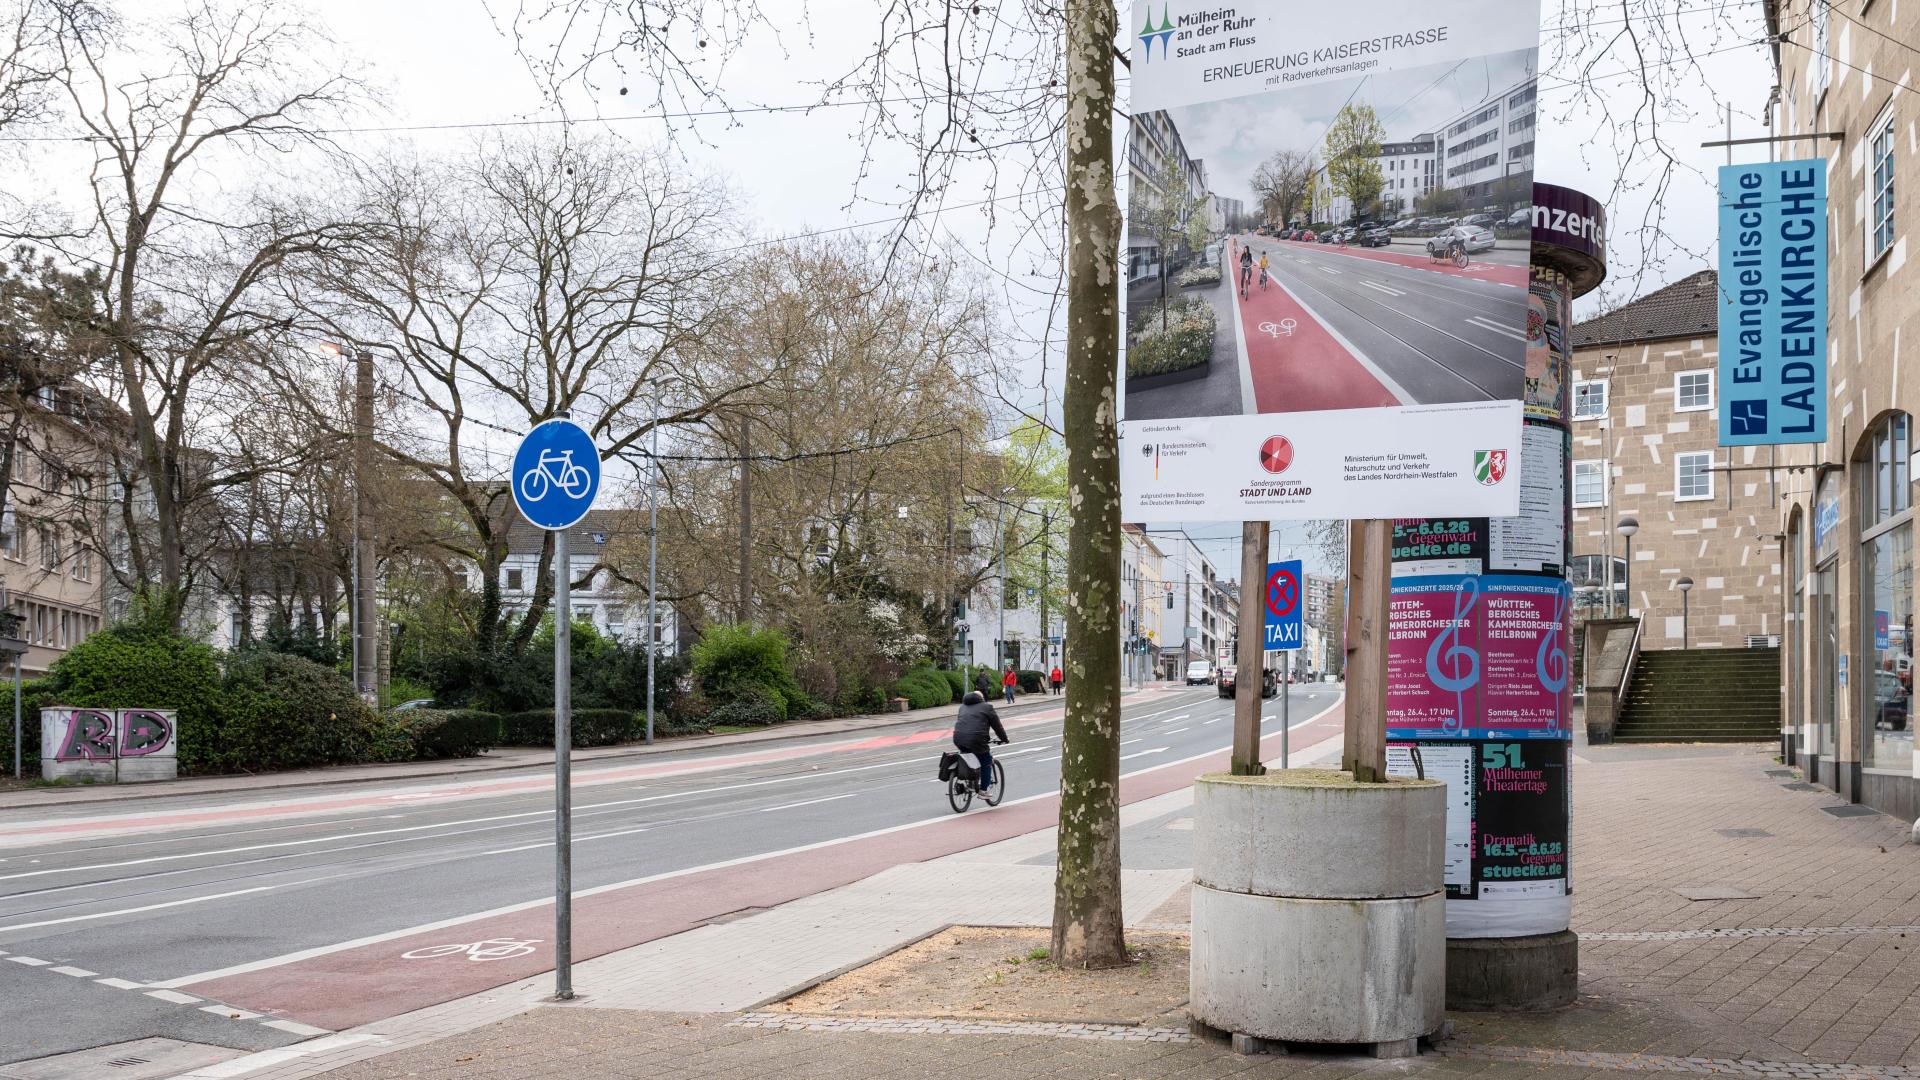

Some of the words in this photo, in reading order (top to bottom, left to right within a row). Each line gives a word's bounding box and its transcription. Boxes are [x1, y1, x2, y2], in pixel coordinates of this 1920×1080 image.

[1178, 8, 1235, 27] Mülheim
[1177, 30, 1192, 41] an
[1197, 23, 1219, 37] der
[1223, 17, 1256, 32] Ruhr
[1177, 45, 1206, 58] Stadt
[1209, 42, 1226, 52] am
[1229, 36, 1256, 48] Fluss
[1204, 51, 1308, 82] ERNEUERUNG
[1313, 26, 1448, 63] KAISERSTRASSE
[1265, 75, 1280, 86] mit
[1282, 59, 1379, 82] Radverkehrsanlagen
[1733, 172, 1768, 384] Evangelische
[1781, 168, 1815, 433] LADENKIRCHE
[1344, 455, 1385, 463] Ministerium
[1398, 453, 1428, 461] Umwelt,
[1344, 464, 1385, 472] Naturschutz
[1384, 471, 1458, 480] Nordrhein-Westfalen
[1240, 489, 1266, 497] STADT
[1268, 488, 1286, 496] UND
[1288, 487, 1312, 496] LAND
[1409, 530, 1477, 546] Gegenwart
[1438, 584, 1464, 592] 2025/26
[1487, 584, 1543, 593] SINFONIEKONZERTE
[1487, 598, 1535, 609] WÜRTTEM-
[1488, 609, 1540, 619] BERGISCHES
[1488, 619, 1563, 631] KAMMERORCHESTER
[1265, 622, 1299, 643] TAXI
[1488, 630, 1537, 639] HEILBRONN
[1430, 707, 1439, 716] 17
[1440, 707, 1455, 716] Uhr
[1487, 708, 1519, 718] Sonntag,
[1483, 767, 1543, 781] Mülheimer
[1484, 779, 1549, 795] Theatertage
[1483, 833, 1537, 846] Dramatik
[1520, 852, 1565, 866] Gegenwart
[1482, 862, 1562, 878] stuecke.de
